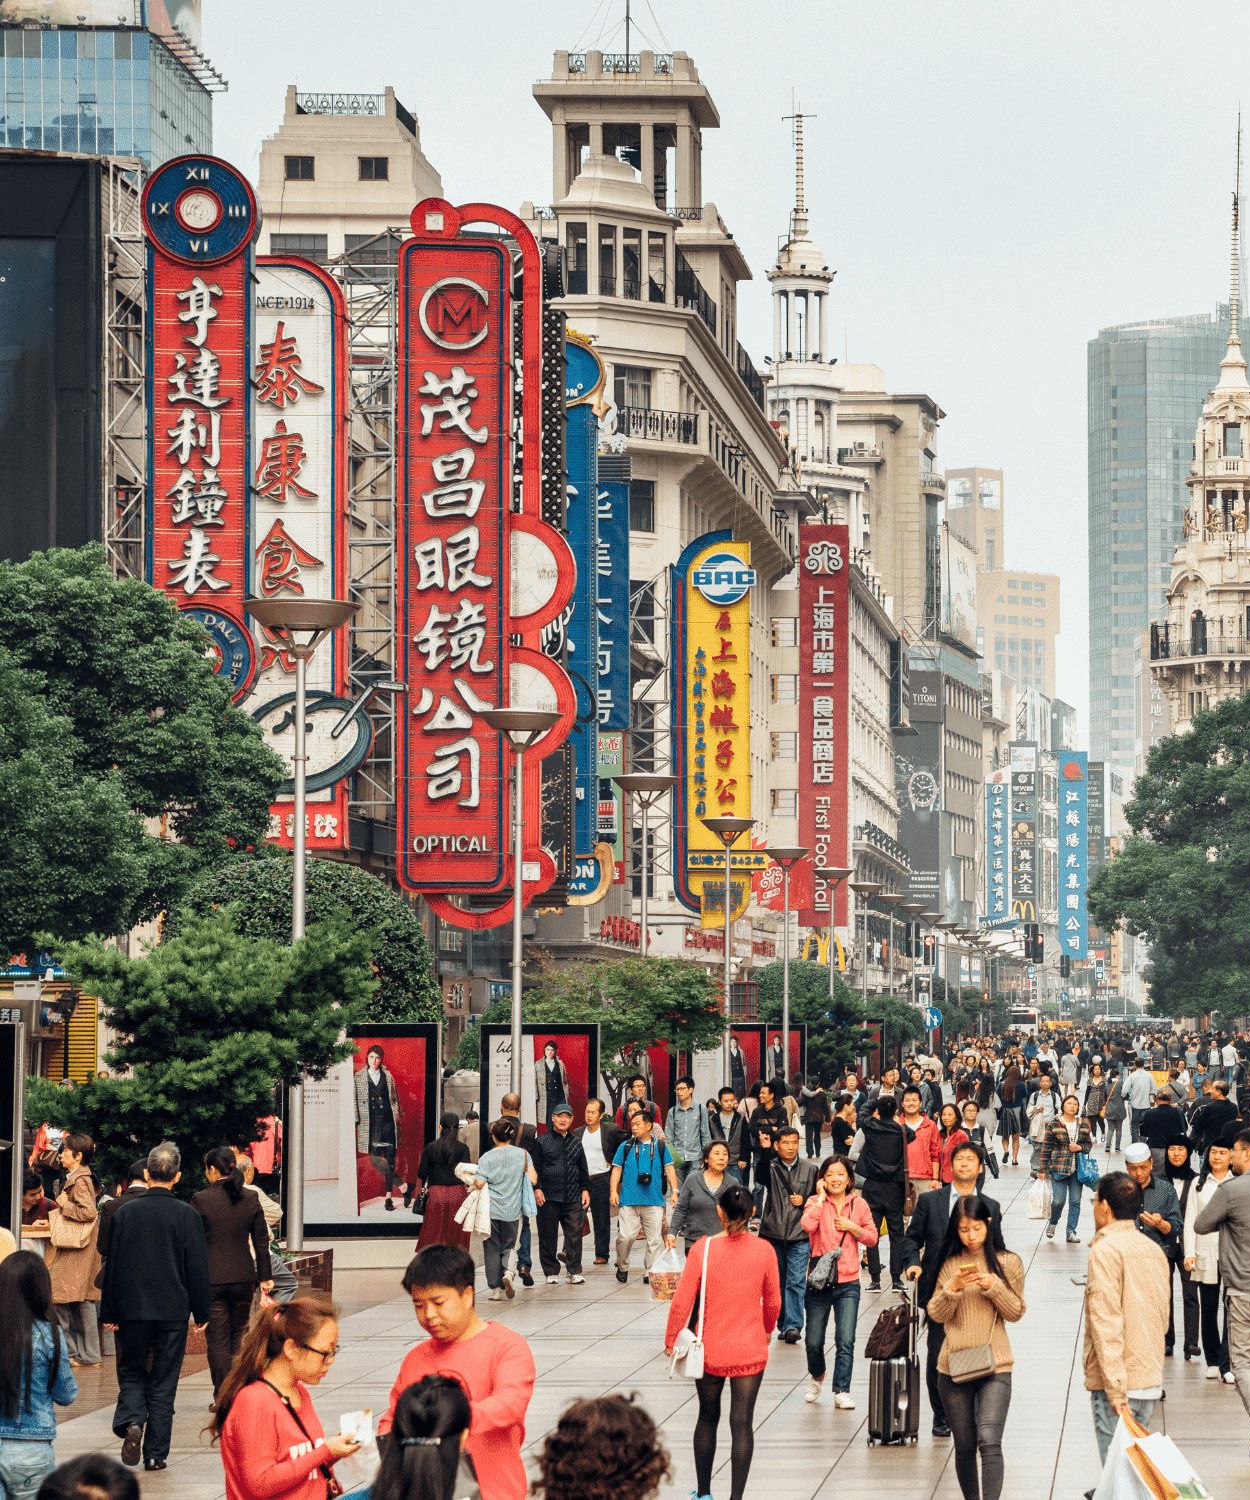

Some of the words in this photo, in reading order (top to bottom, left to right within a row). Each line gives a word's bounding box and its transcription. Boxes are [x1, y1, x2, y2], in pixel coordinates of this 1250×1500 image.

[836, 15, 932, 298] 际广场
[186, 166, 210, 181] XII
[151, 202, 170, 215] IX
[228, 204, 246, 217] III
[189, 239, 208, 253] VI
[413, 365, 494, 808] 茂昌眼镜公司
[693, 570, 755, 586] BAC
[812, 585, 834, 784] 上海市第一食品商店
[912, 693, 937, 703] TITONI
[815, 796, 831, 832] First
[413, 835, 492, 854] OPTICAL
[814, 834, 831, 870] Foo
[688, 854, 766, 867] 创建于942年
[1018, 849, 1034, 894] 真丝大王
